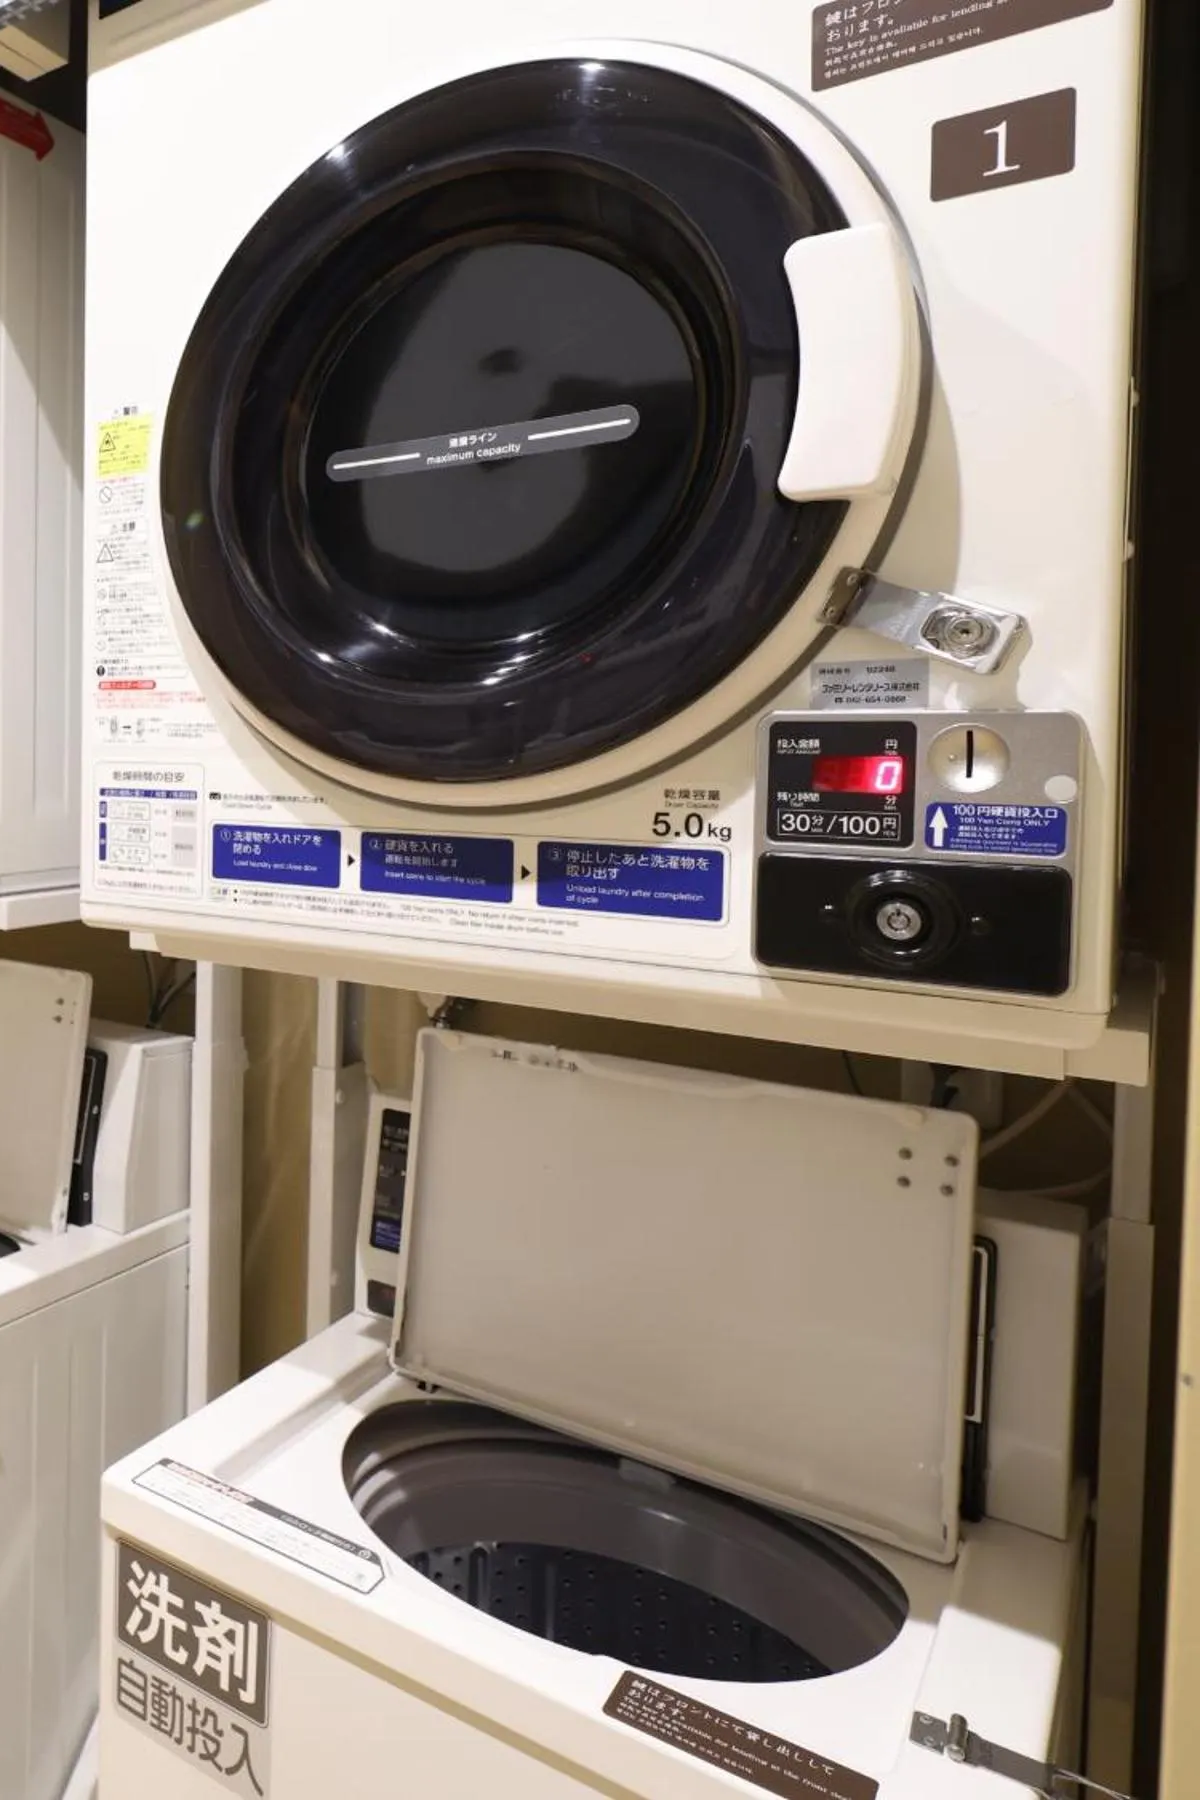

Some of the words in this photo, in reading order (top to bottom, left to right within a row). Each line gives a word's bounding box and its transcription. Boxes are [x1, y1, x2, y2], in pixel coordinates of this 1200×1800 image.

[826, 13, 894, 42] おります。
[847, 38, 866, 50] key
[982, 119, 1021, 177] 1
[426, 449, 475, 466] maximum
[476, 442, 521, 458] capacity
[884, 738, 898, 750] 円
[874, 760, 902, 791] 0
[960, 816, 975, 824] 100
[1023, 819, 1051, 827] ONLY
[566, 848, 711, 871] 停止したあと洗濯物を
[565, 864, 621, 880] 取り出す
[565, 883, 597, 894] Unload
[597, 885, 630, 898] laundry
[631, 888, 651, 898] after
[653, 889, 706, 902] completion
[565, 893, 574, 902] of
[576, 895, 599, 905] cycle
[124, 1560, 259, 1705] 洗剤
[627, 1688, 686, 1721] おります。
[117, 1655, 264, 1798] 自動投入
